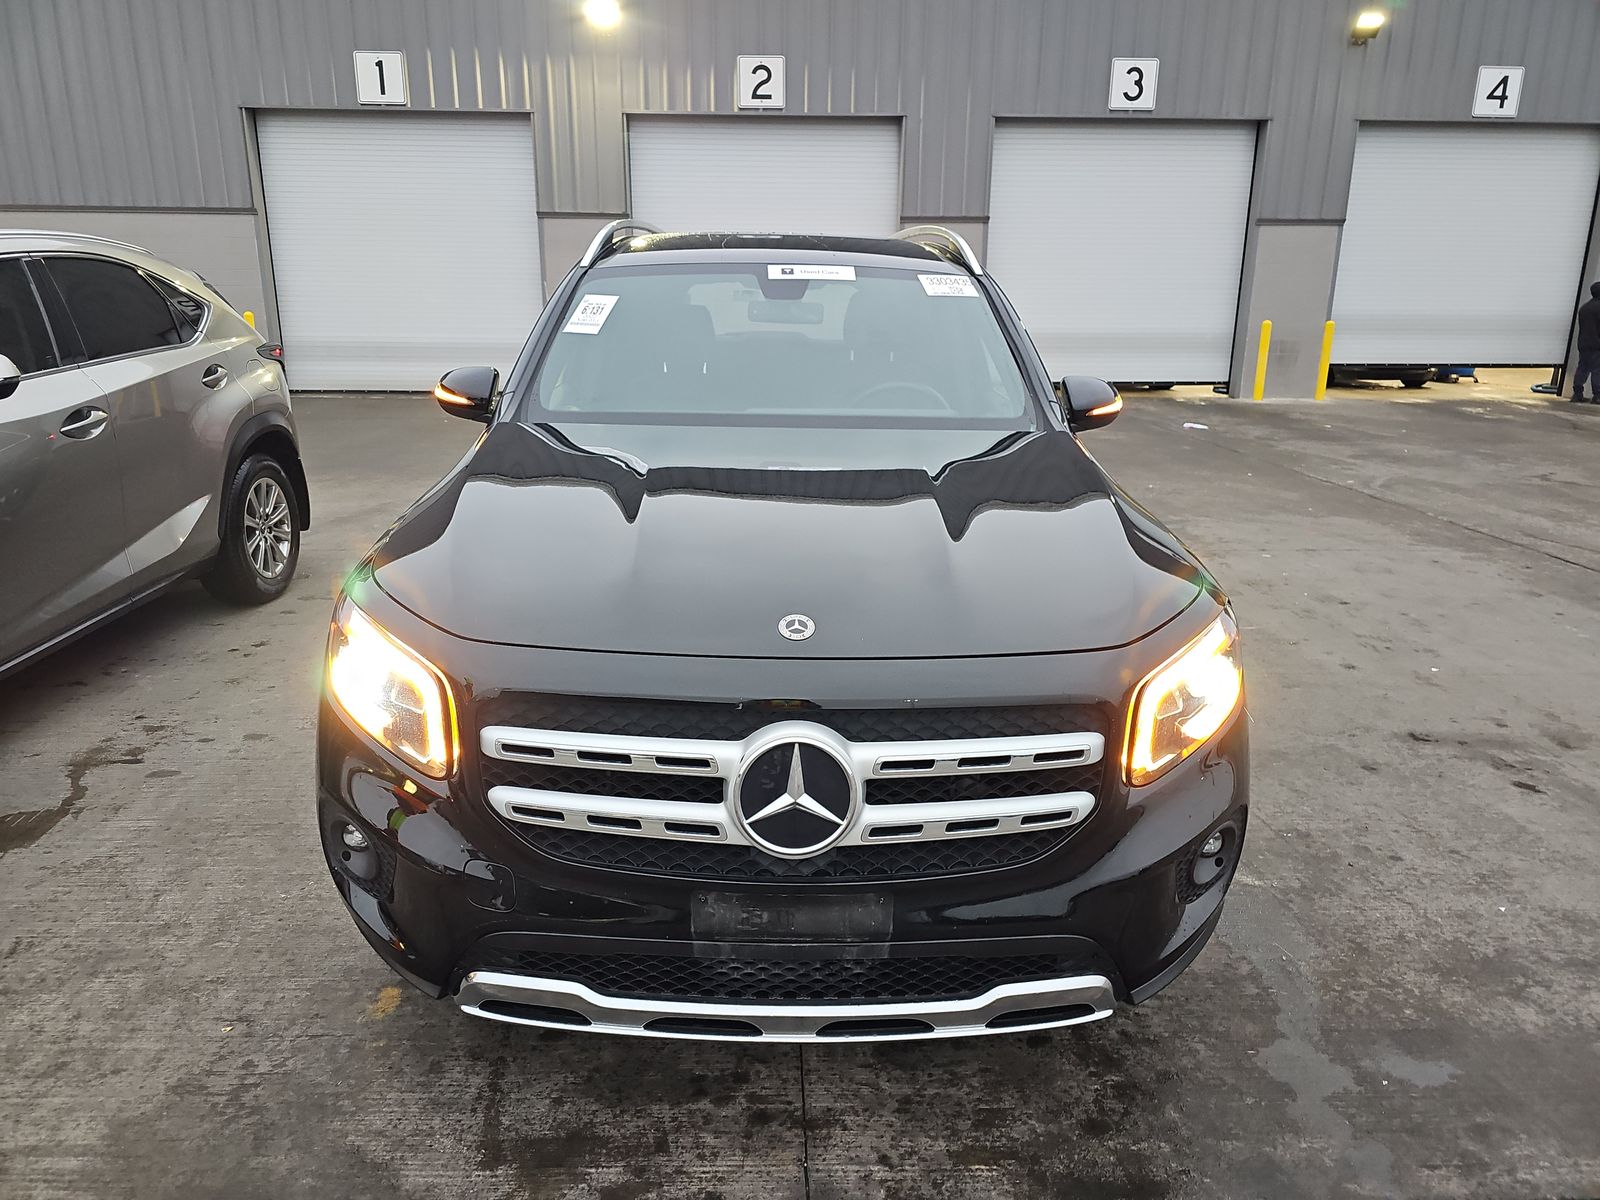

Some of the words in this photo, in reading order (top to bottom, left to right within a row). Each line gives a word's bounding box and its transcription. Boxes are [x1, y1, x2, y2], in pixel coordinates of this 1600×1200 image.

[375, 60, 386, 95] 1
[751, 64, 772, 99] 2
[1122, 66, 1144, 101] 3
[1486, 75, 1509, 109] 4
